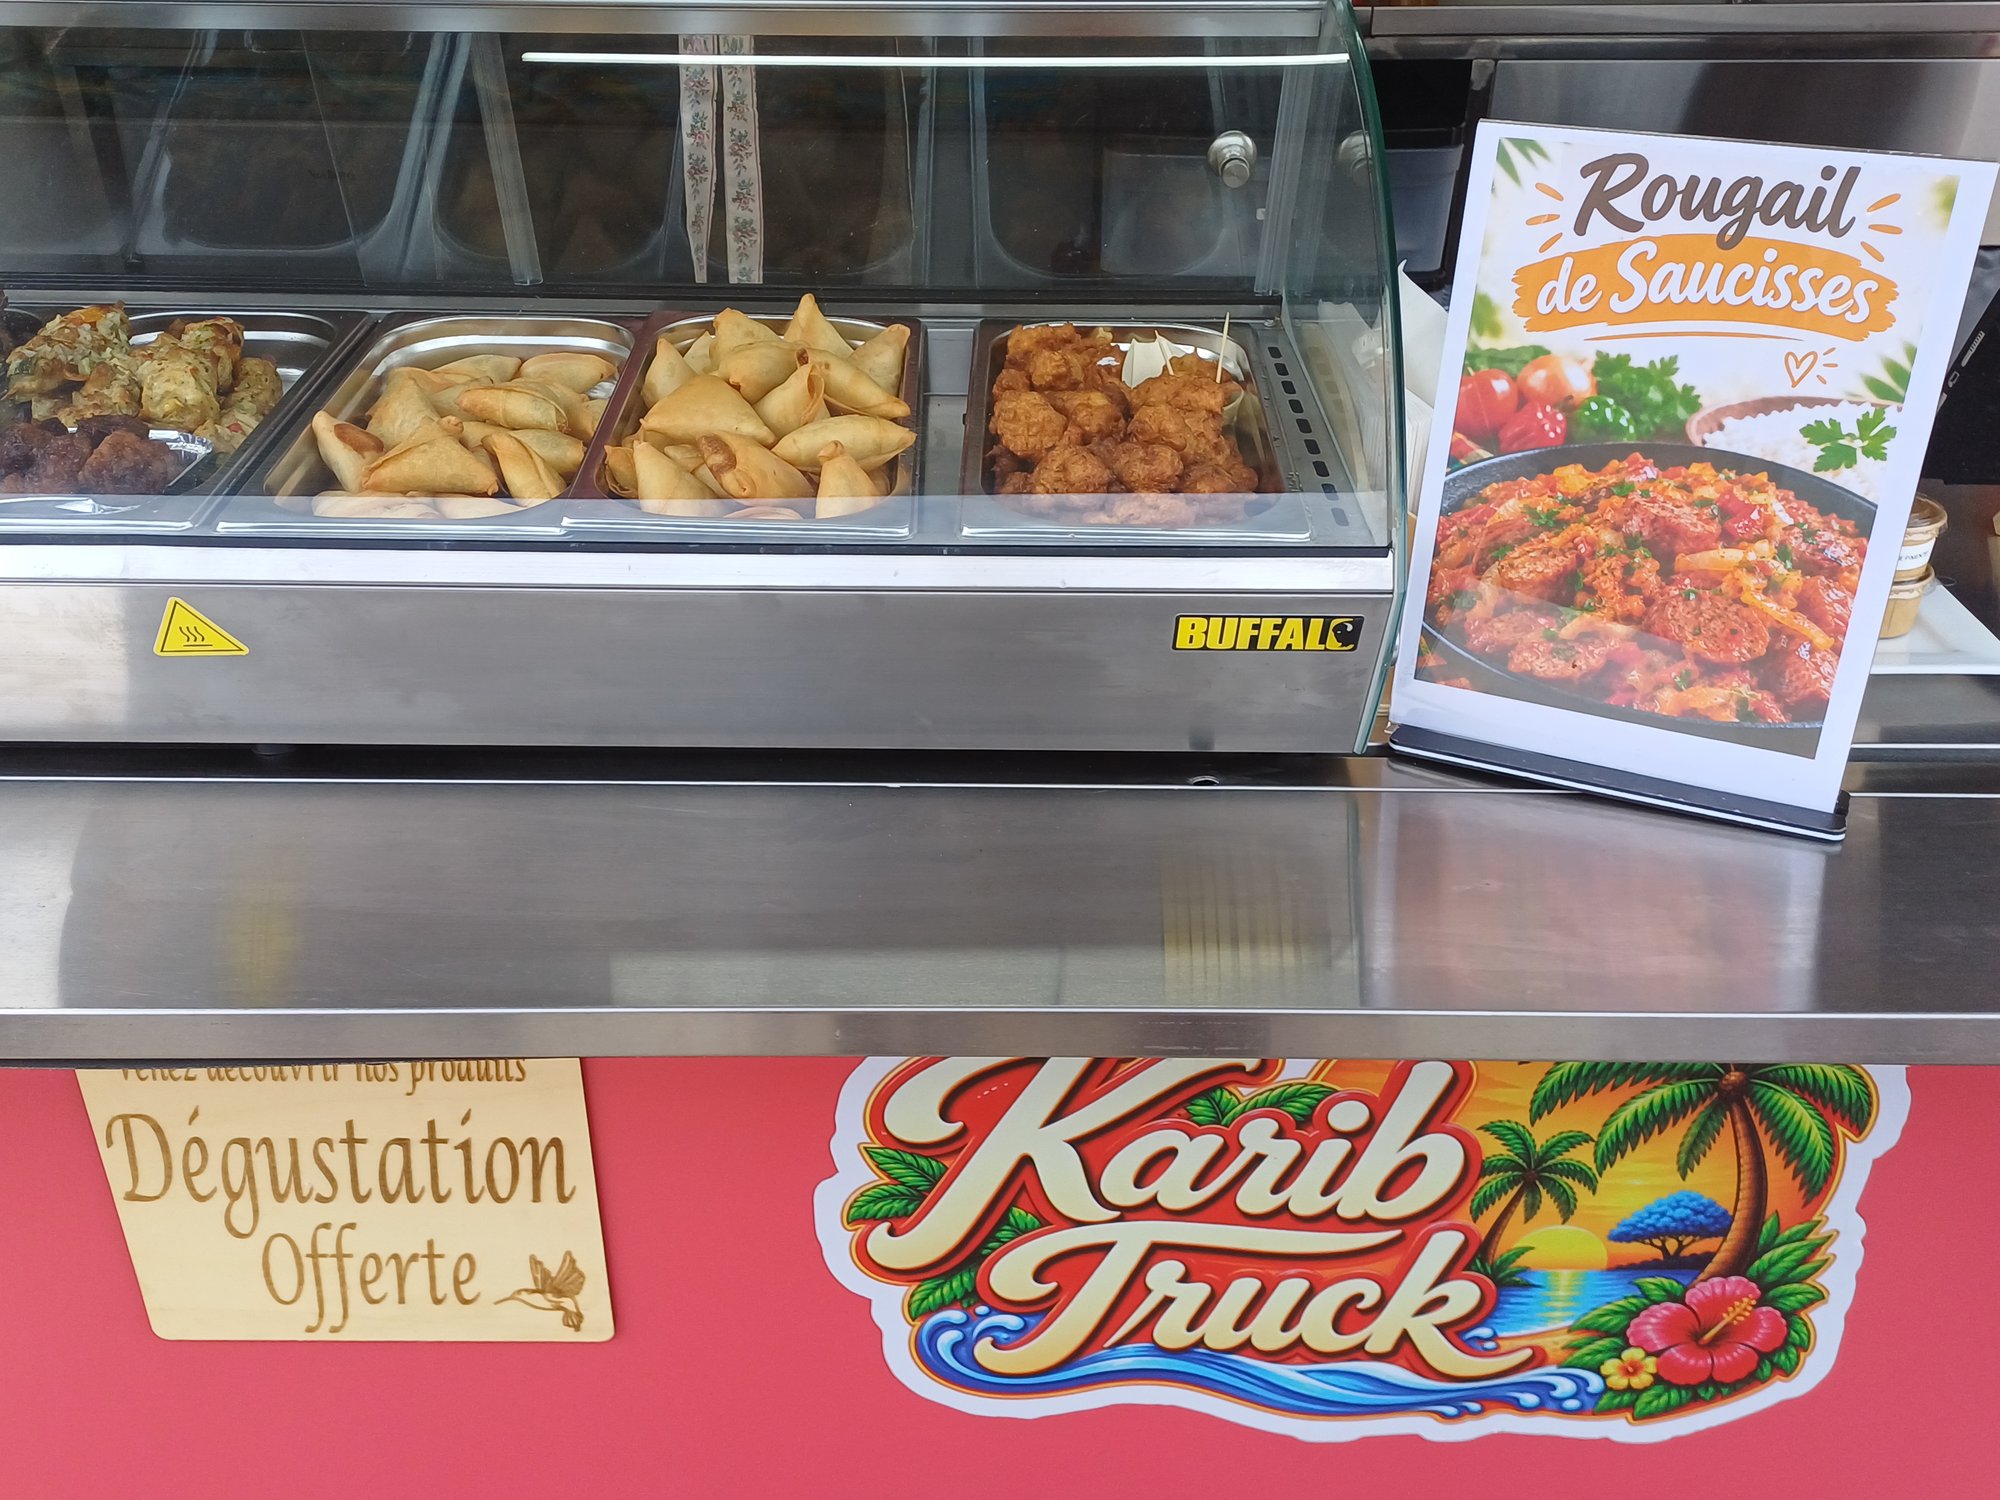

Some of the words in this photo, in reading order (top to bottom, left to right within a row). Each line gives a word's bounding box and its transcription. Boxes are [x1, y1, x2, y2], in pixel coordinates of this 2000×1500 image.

[1573, 152, 1862, 250] Rougail
[1536, 257, 1601, 316] de
[1608, 241, 1879, 324] Saucisses
[105, 1105, 577, 1239] Dégustation
[866, 1057, 1465, 1270] Karib
[262, 1222, 481, 1334] Offerte
[973, 1220, 1533, 1377] Truck
